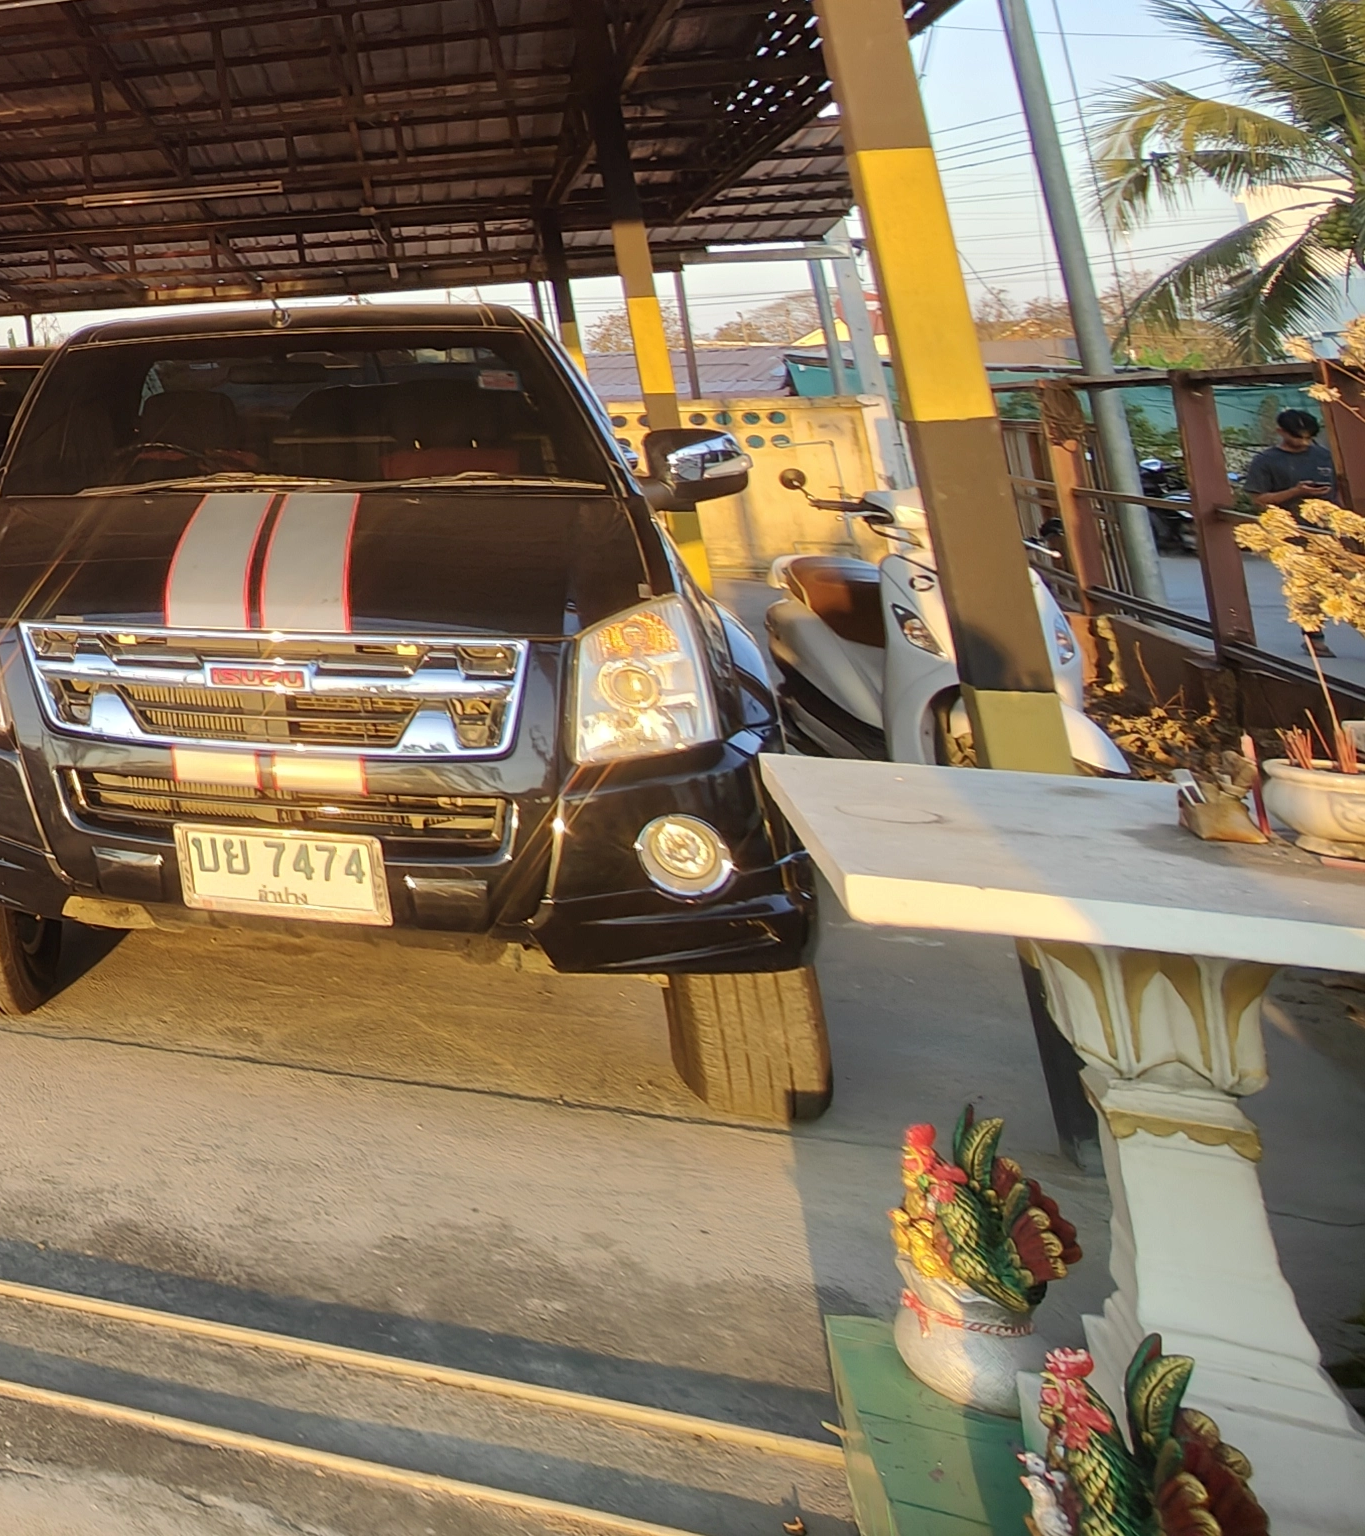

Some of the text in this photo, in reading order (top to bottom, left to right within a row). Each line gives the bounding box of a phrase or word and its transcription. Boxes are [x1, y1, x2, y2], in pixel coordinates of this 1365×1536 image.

[210, 668, 305, 689] ISUZU
[191, 837, 366, 885] บย 7474
